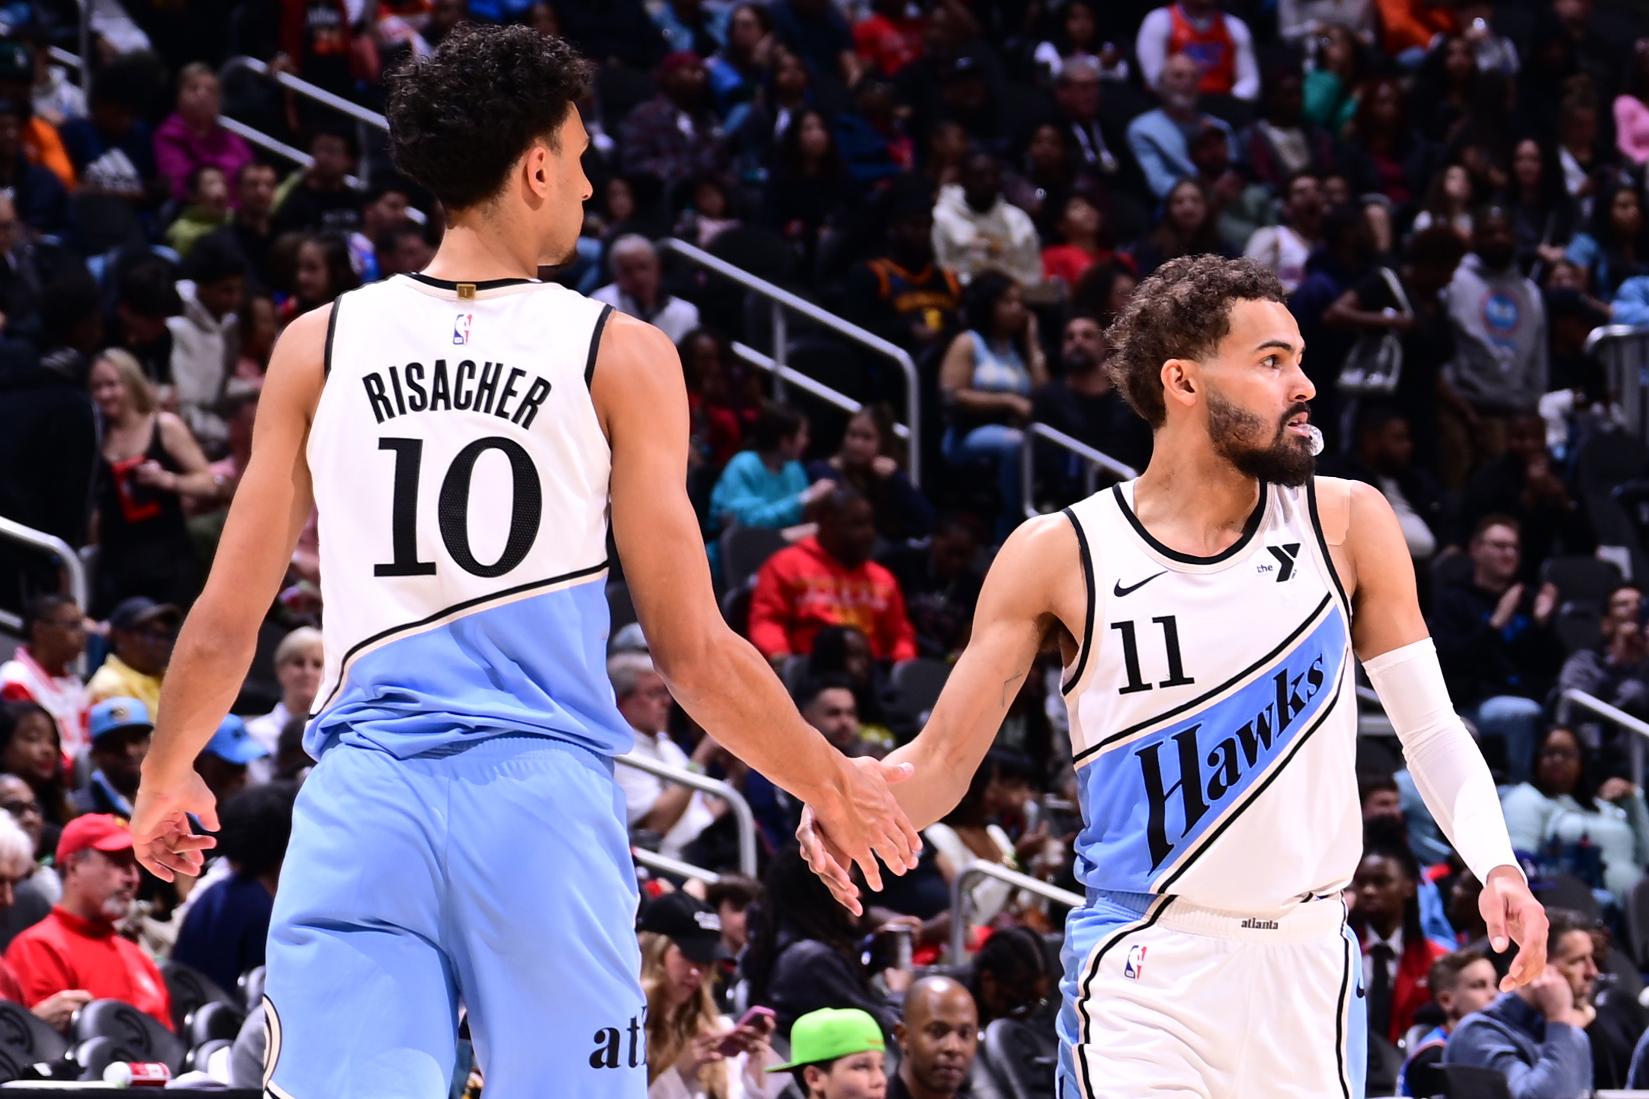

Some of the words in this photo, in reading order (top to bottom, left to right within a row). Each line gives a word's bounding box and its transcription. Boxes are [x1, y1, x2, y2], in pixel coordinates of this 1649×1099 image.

[362, 359, 552, 430] RISACHER
[374, 436, 543, 578] 10
[1256, 563, 1274, 574] the
[1111, 615, 1195, 695] 11
[1135, 653, 1325, 877] Hawks
[1241, 917, 1279, 930] atlanta
[589, 1005, 647, 1069] at
